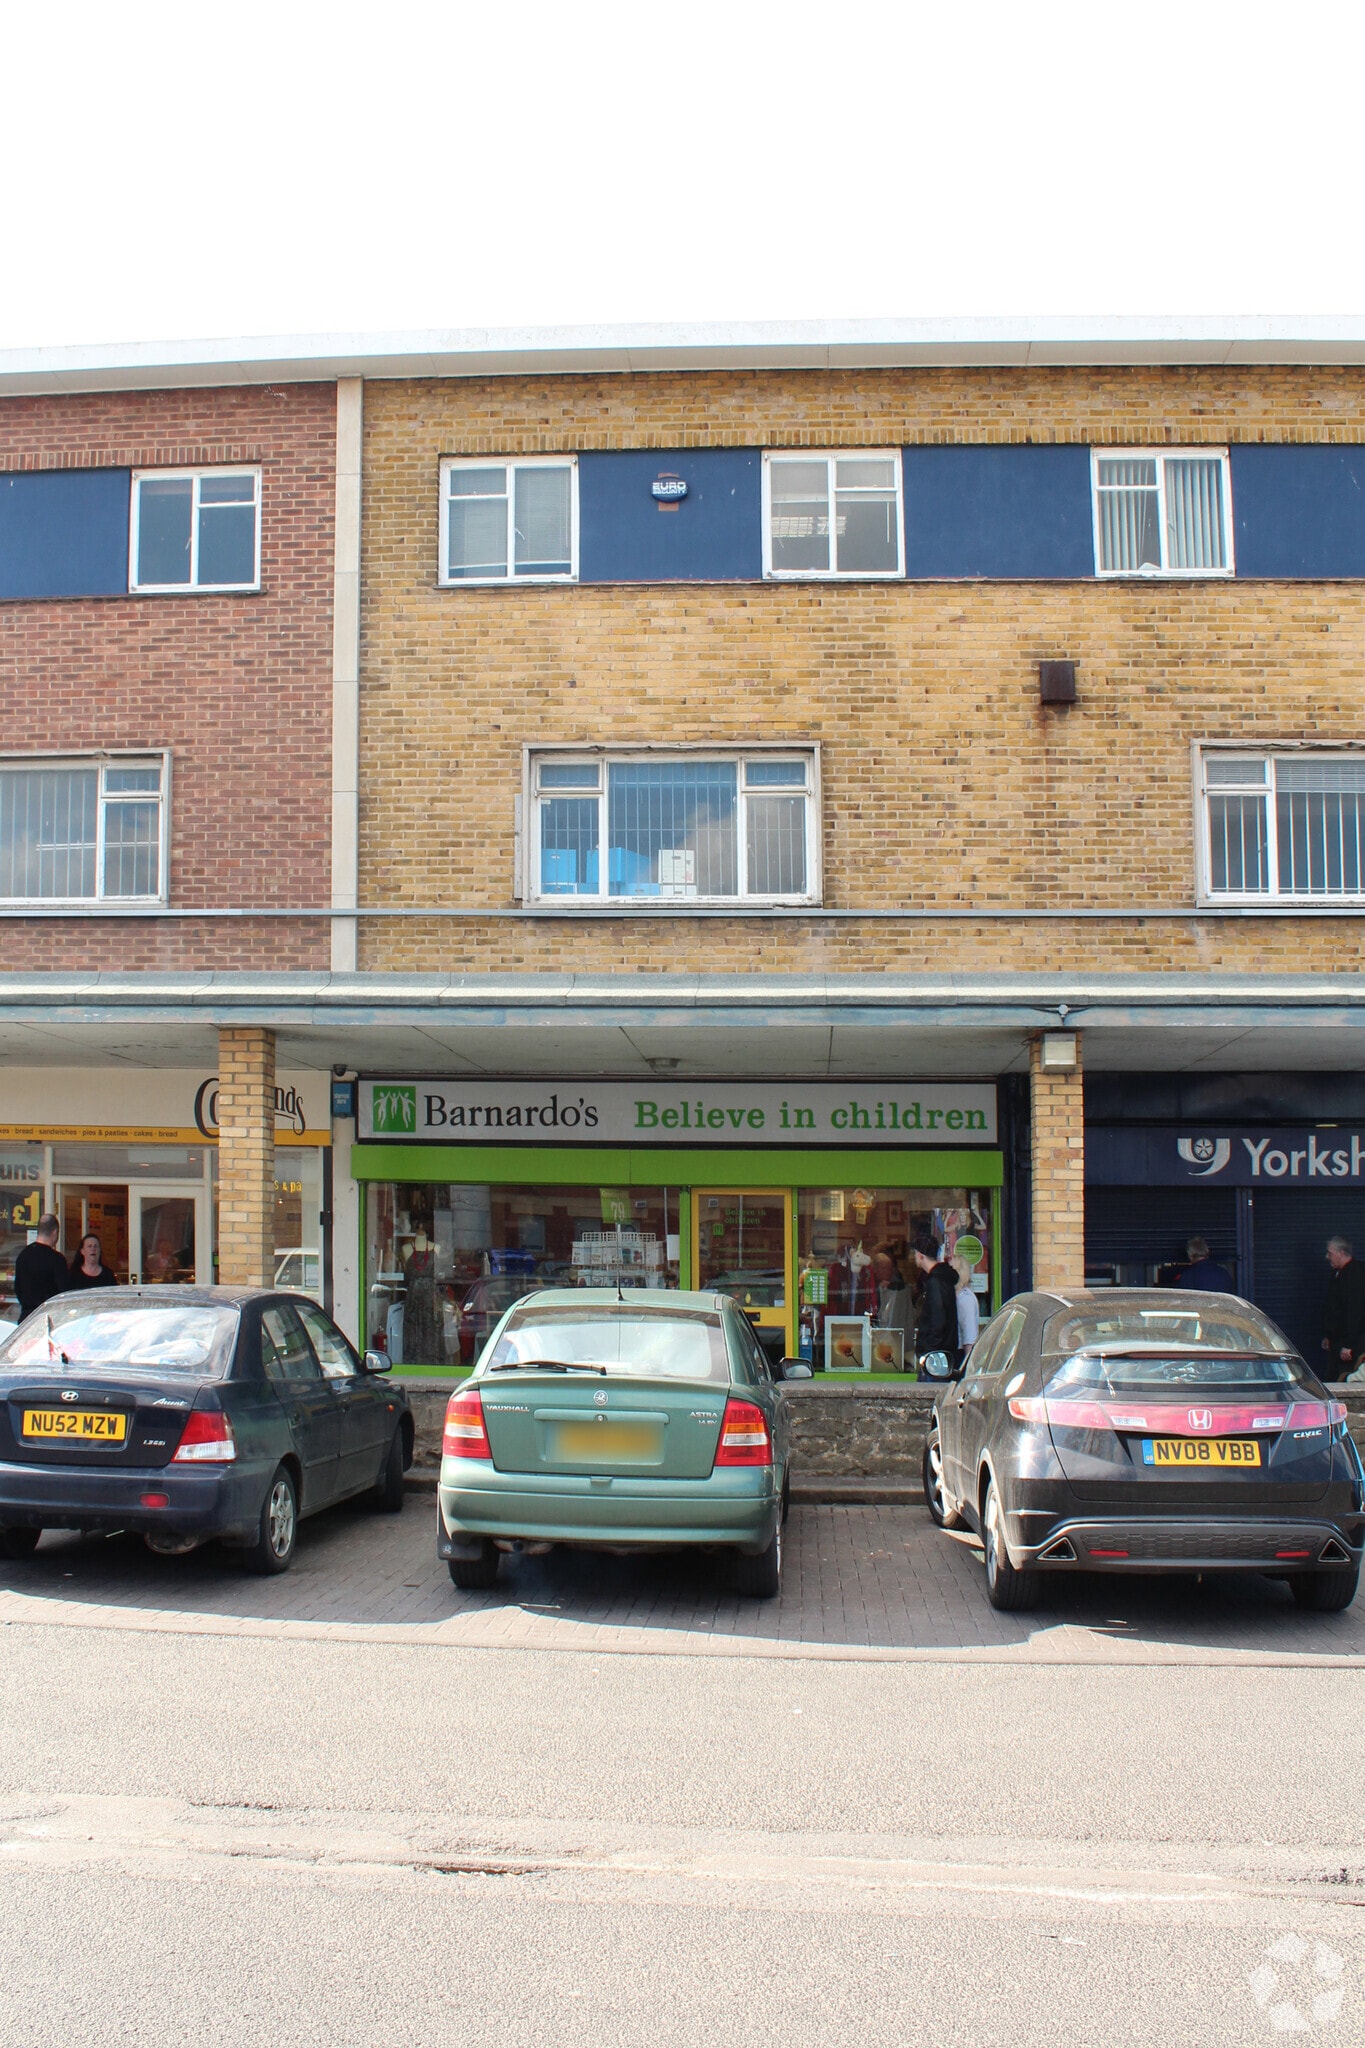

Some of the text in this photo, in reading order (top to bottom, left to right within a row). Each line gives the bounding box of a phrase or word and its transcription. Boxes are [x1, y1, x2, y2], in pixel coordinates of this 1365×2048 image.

[652, 482, 687, 490] EURO
[424, 1095, 599, 1128] Barnardo's
[634, 1101, 988, 1130] Believe in children
[39, 1128, 77, 1136] sandwiches
[82, 1129, 96, 1137] pies
[104, 1129, 128, 1138] pasties
[1241, 1135, 1365, 1176] Yorksh
[13, 1191, 40, 1226] £1
[486, 1404, 530, 1412] VAUXHALL
[31, 1413, 118, 1435] NU52 MZW
[1293, 1429, 1323, 1439] CIVIC
[1156, 1441, 1256, 1461] NV08 VBB
